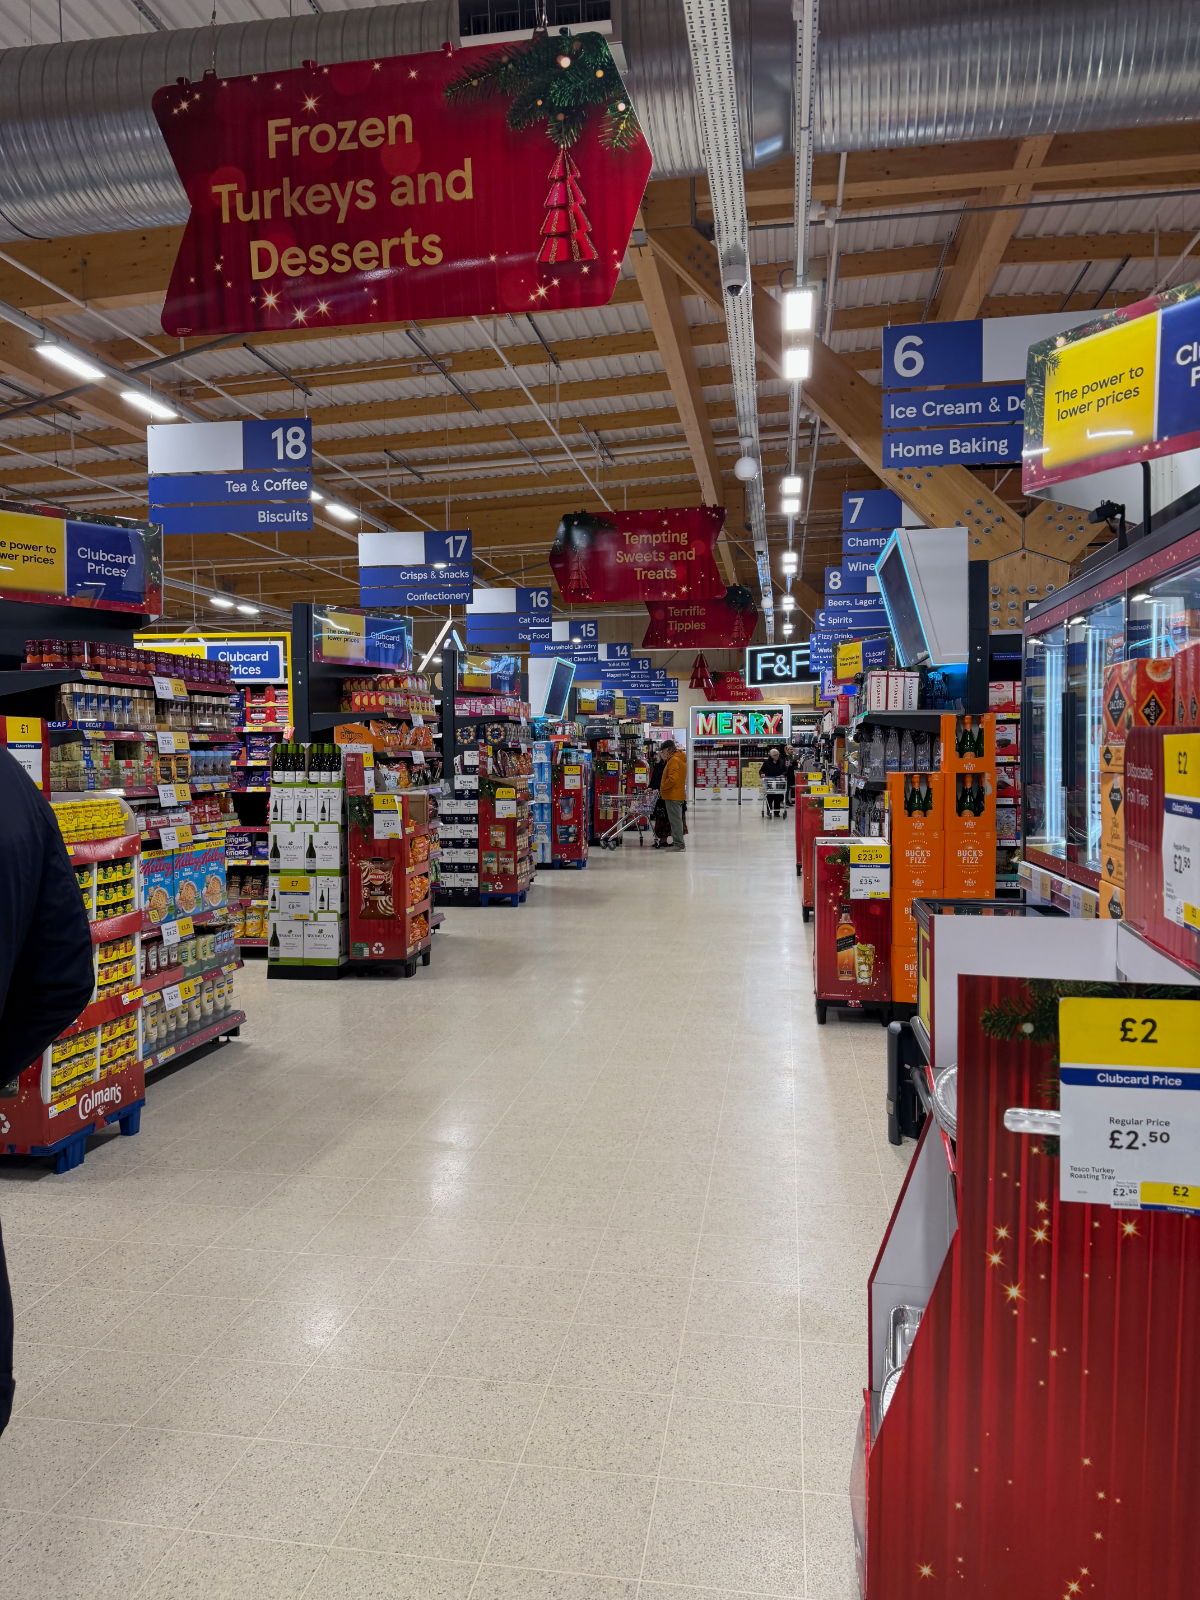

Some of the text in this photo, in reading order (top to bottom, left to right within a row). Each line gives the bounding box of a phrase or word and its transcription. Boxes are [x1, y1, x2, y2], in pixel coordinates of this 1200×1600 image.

[267, 112, 414, 160] Frozen
[212, 158, 474, 224] Turkeys and
[249, 227, 444, 281] Desserts
[892, 335, 925, 378] 6
[1055, 366, 1145, 405] The power to
[890, 397, 1001, 420] Ice Cream &
[1056, 383, 1140, 422] lower prices
[271, 426, 307, 460] 18
[889, 437, 1009, 459] Home Baking
[226, 478, 309, 494] Tea & Coffee
[257, 510, 309, 524] Biscuits
[848, 498, 865, 524] 7
[623, 530, 689, 548] Tempting
[9, 541, 43, 553] power
[46, 544, 57, 554] to
[445, 535, 468, 559] 17
[22, 554, 55, 566] prices
[77, 547, 136, 566] Clubcard
[616, 547, 697, 564] Sweets and
[87, 562, 128, 578] Prices
[634, 567, 678, 581] Treats
[847, 561, 876, 573] Wine
[400, 570, 470, 582] Crisps & Snacks
[828, 571, 842, 590] 8
[406, 592, 471, 603] Confectionery
[529, 591, 549, 608] 16
[828, 599, 853, 607] Beers,
[854, 598, 876, 607] Lager
[667, 606, 707, 618] Terrific
[533, 616, 550, 624] Food
[667, 620, 707, 633] Tipples
[828, 616, 853, 625] Spirits
[371, 632, 400, 642] Clubcard
[518, 632, 550, 641] Dog Food
[580, 623, 596, 637] 15
[817, 633, 833, 641] Fizzy
[375, 640, 396, 650] Prices
[575, 643, 597, 651] Laundry
[615, 645, 628, 657] 14
[218, 651, 269, 662] Clubcard
[638, 659, 650, 670] 13
[757, 649, 810, 681] F&F
[656, 670, 665, 679] 12
[670, 679, 678, 687] 11
[21, 724, 29, 734] £1
[697, 712, 783, 735] MERRY
[1178, 751, 1188, 775] £2
[1127, 762, 1154, 782] Disposable
[180, 789, 187, 797] £3
[1126, 786, 1150, 810] Foil Trays
[1174, 853, 1191, 874] £2.50
[184, 987, 191, 995] £4
[1120, 1017, 1158, 1044] £2
[1096, 1072, 1183, 1086] Clubcard Price
[79, 1083, 122, 1120] Colman's
[1109, 1117, 1171, 1127] Regular Price
[1109, 1129, 1171, 1150] £2.50
[1070, 1165, 1115, 1174] Tesco Turkey
[1070, 1172, 1100, 1181] Roasting
[1112, 1187, 1138, 1197] £2.50
[1172, 1186, 1189, 1197] £2
